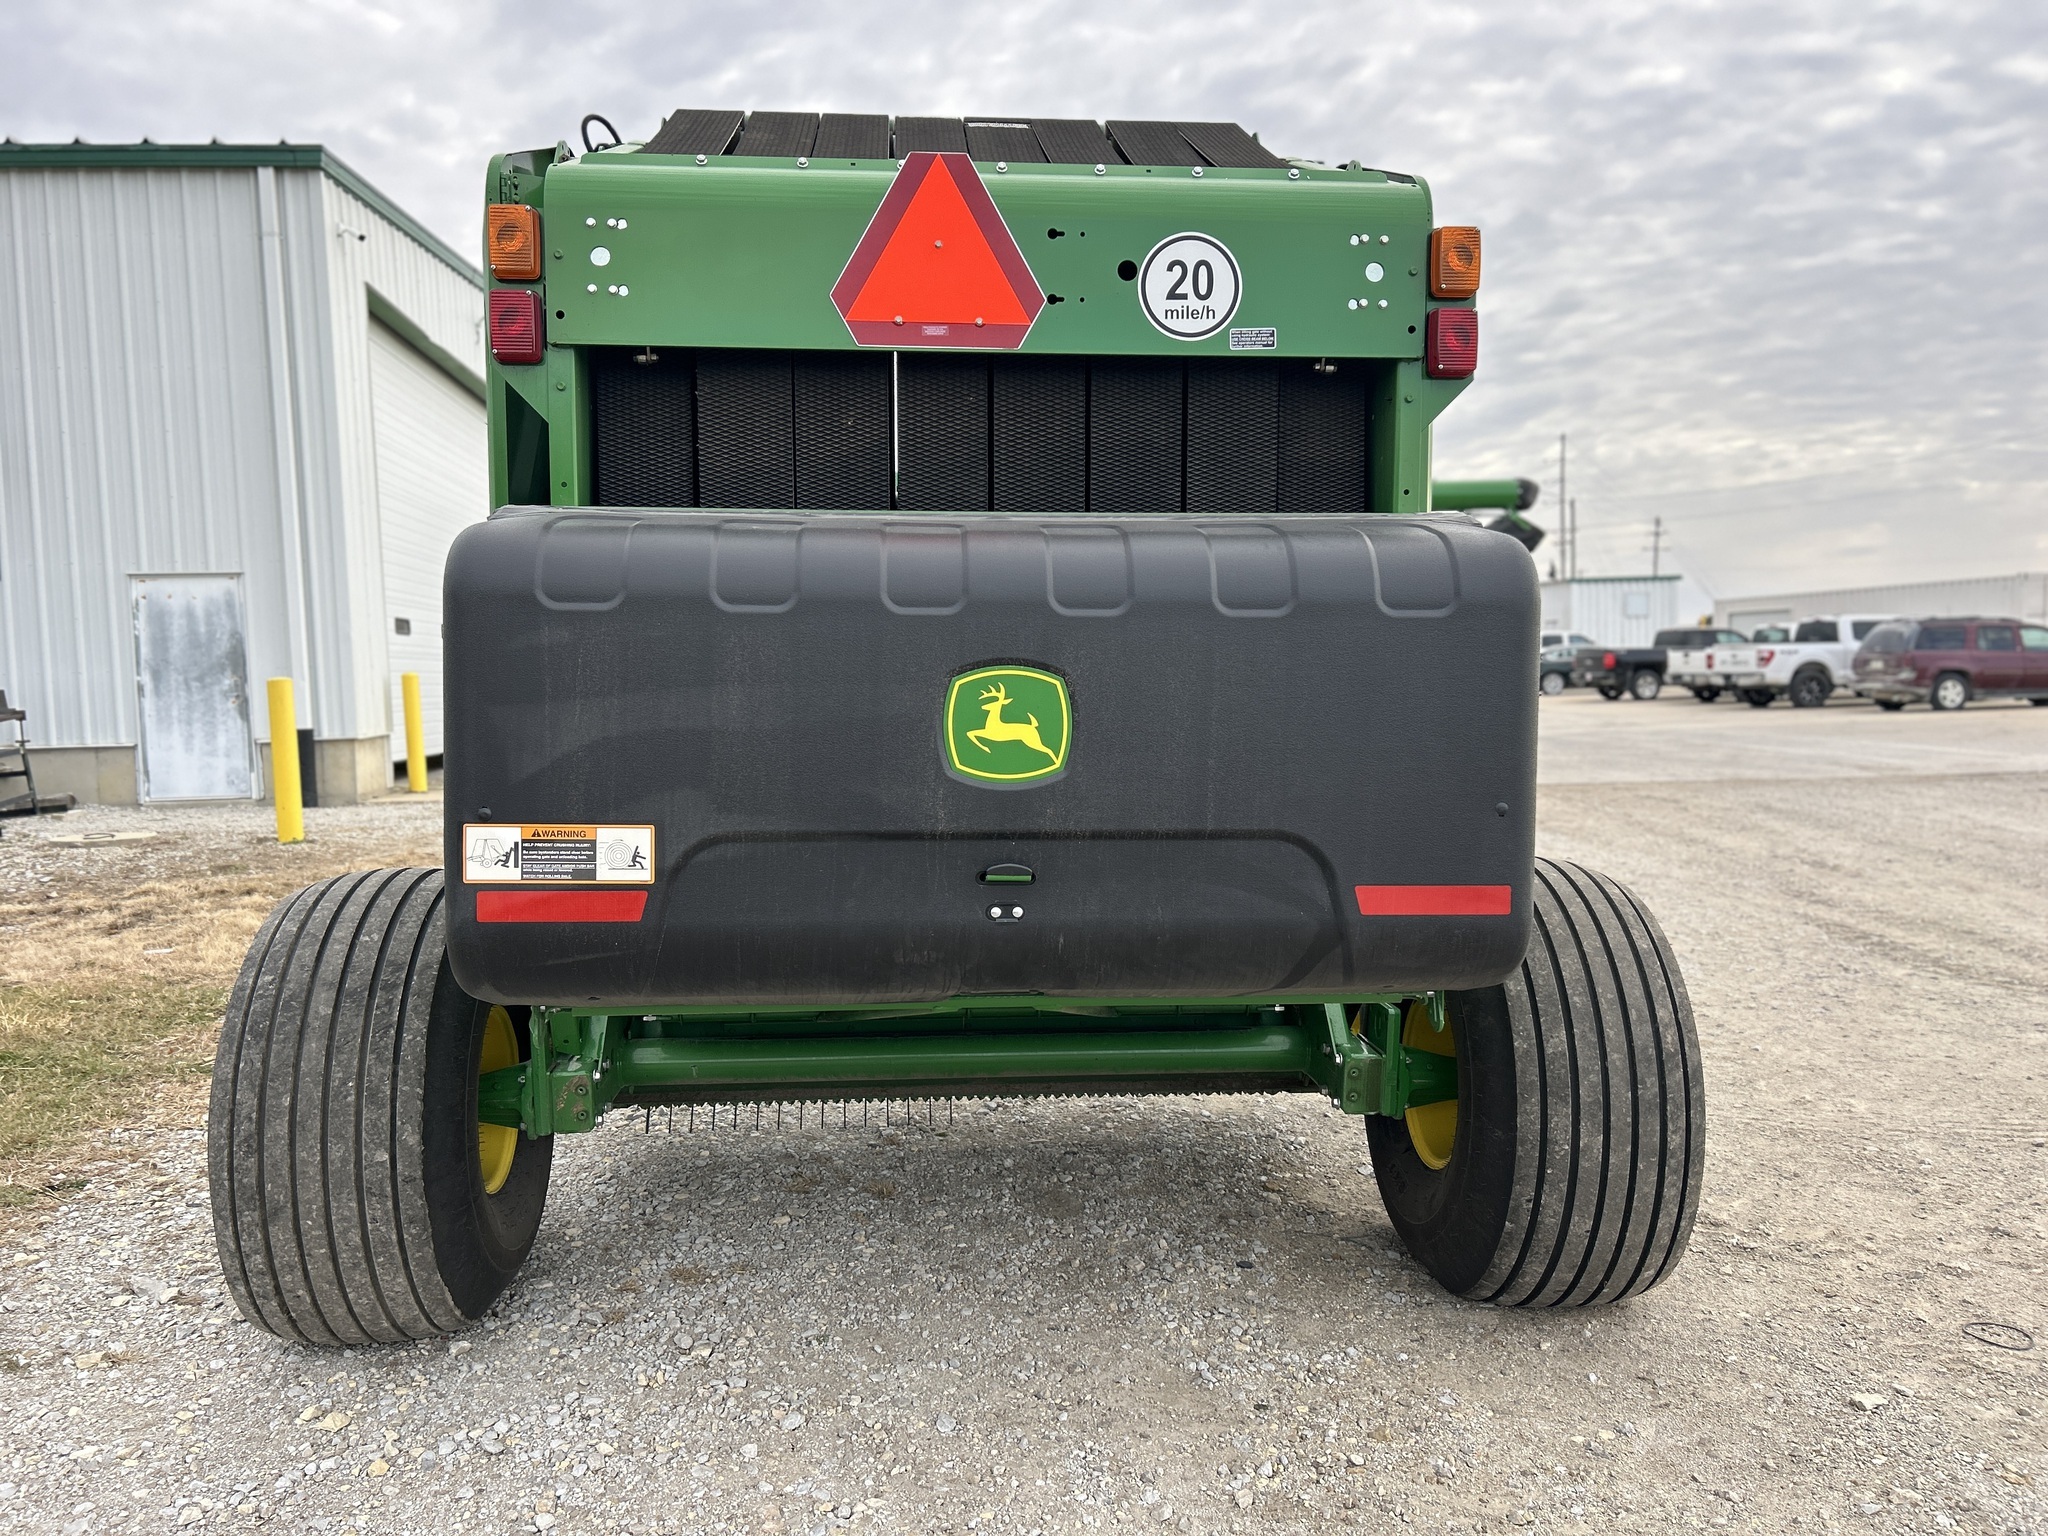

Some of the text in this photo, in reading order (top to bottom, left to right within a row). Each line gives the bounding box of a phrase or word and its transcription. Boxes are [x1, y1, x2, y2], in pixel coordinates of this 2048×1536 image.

[1165, 259, 1214, 301] 20
[1164, 304, 1216, 320] mile/h
[542, 830, 586, 838] WARNING
